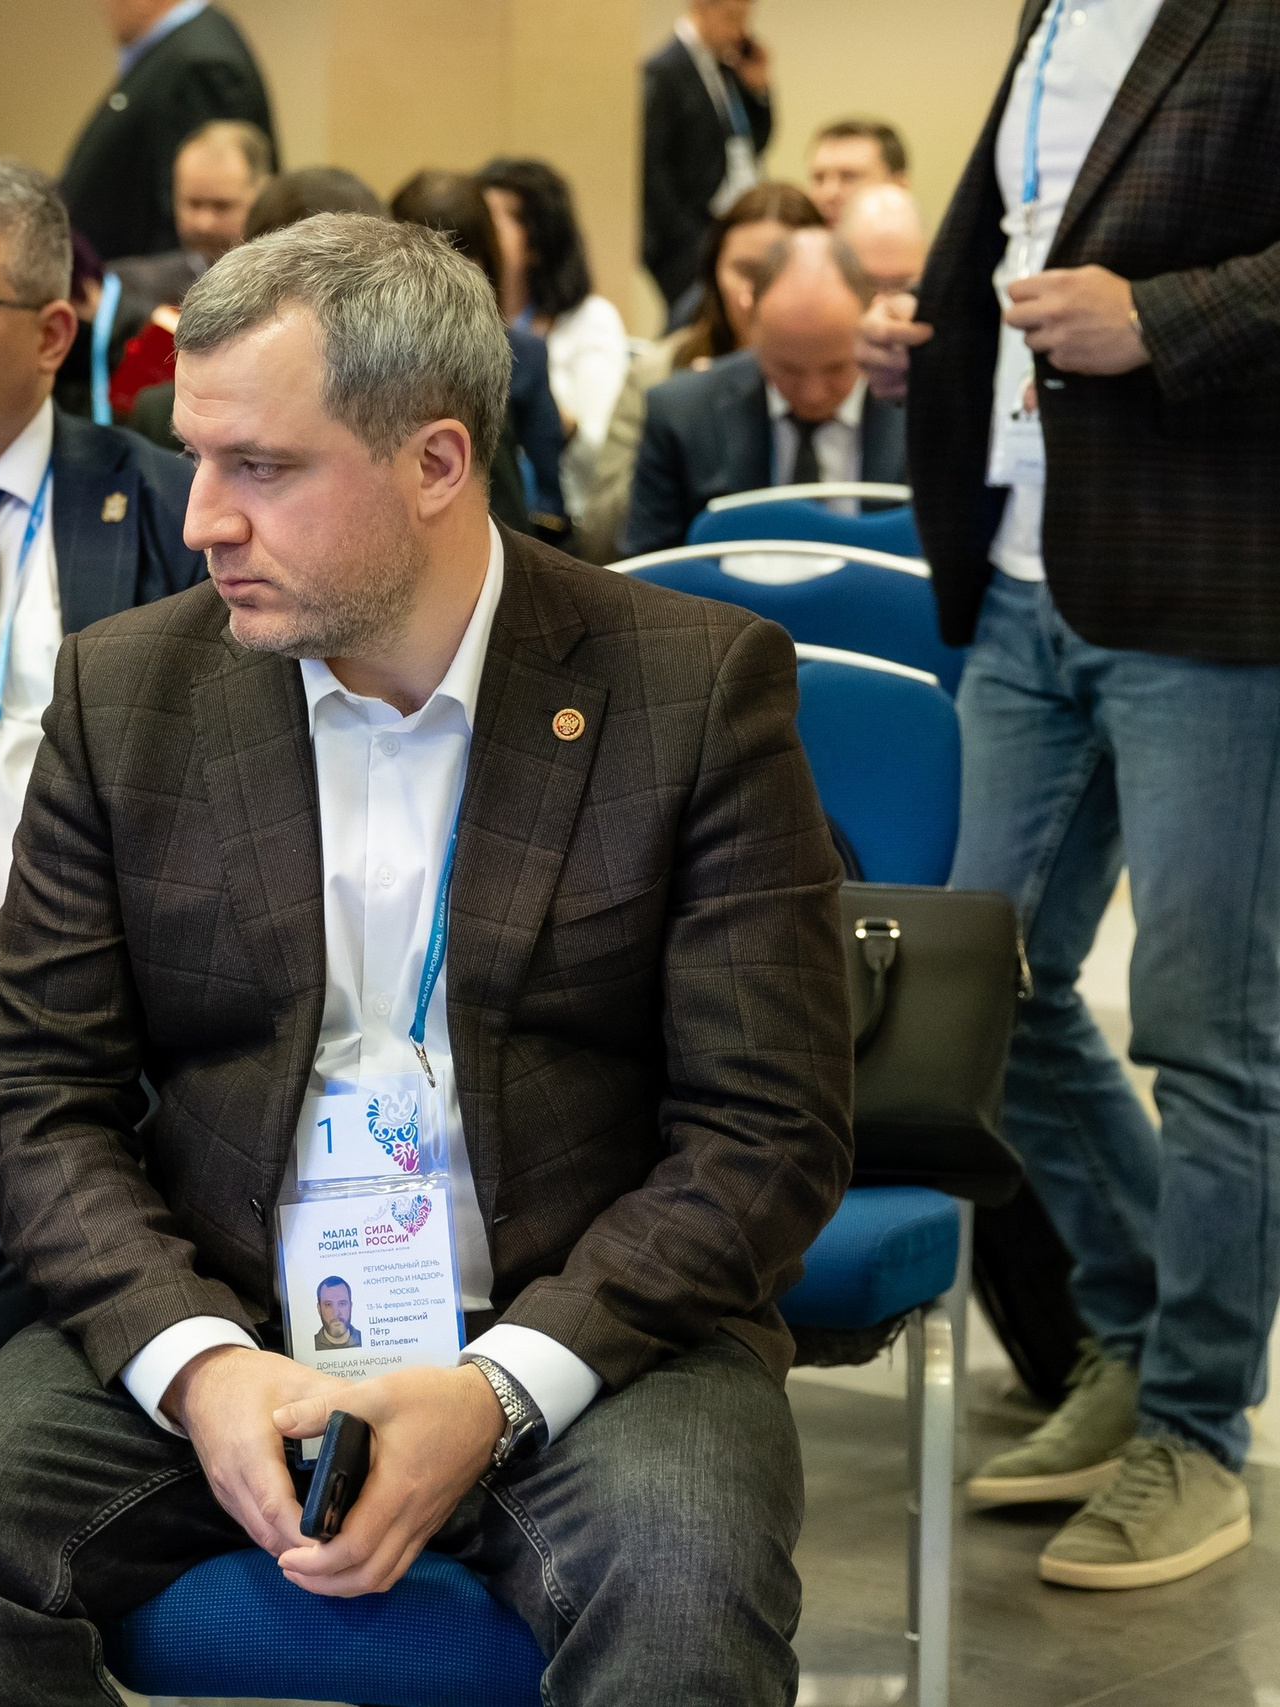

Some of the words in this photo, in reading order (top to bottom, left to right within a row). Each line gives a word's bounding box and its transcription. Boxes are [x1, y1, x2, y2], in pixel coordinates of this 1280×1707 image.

[421, 974, 433, 1008] МАЛАЯ
[429, 933, 443, 973] РОДИНА
[438, 901, 446, 929] СИЛА
[317, 1117, 333, 1154] 1
[322, 1227, 358, 1240] МАЛАЯ
[364, 1224, 394, 1236] СИЛА
[318, 1239, 359, 1251] РОДИНА
[365, 1233, 409, 1247] РОССИИ
[363, 1259, 420, 1274] РЕГИОНАЛЬНЫЙ
[420, 1259, 440, 1270] ДЕНЬ
[363, 1275, 405, 1286] «КОНТРОЛЬ
[412, 1271, 444, 1282] НАДЗОР»
[389, 1286, 420, 1296] МОСКВА
[366, 1302, 383, 1311] 13-14
[384, 1300, 412, 1311] февраля
[412, 1297, 430, 1306] 2025
[430, 1297, 446, 1306] года
[368, 1312, 428, 1325] Шимановский
[369, 1327, 391, 1338] Пётр
[370, 1337, 419, 1347] Витальевич
[316, 1360, 358, 1371] ДОНЕЦКАЯ
[360, 1356, 402, 1366] НАРОДНАЯ
